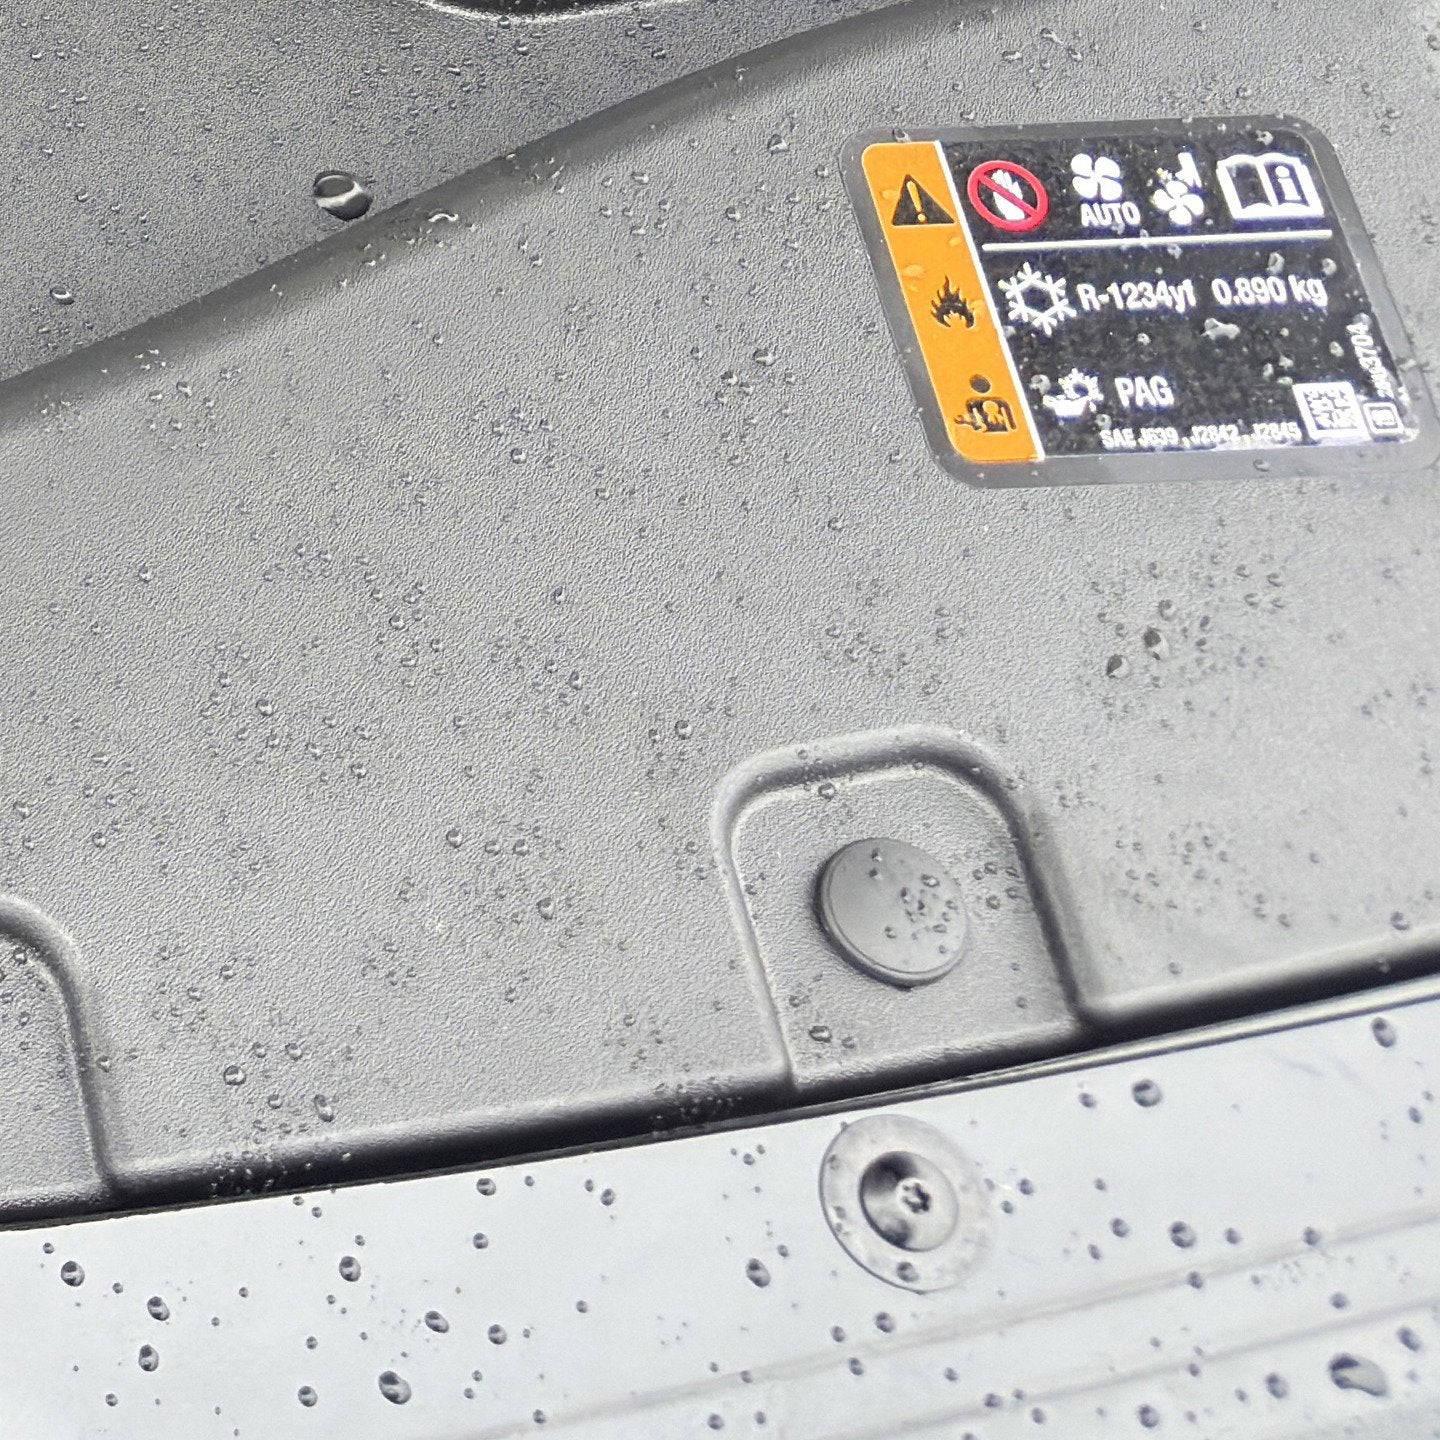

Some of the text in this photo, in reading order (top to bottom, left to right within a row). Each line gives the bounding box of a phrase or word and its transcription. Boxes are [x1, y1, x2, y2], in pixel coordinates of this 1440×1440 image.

[1080, 201, 1141, 227] AUTO
[1076, 274, 1328, 313] R-1234yf 0.890 kg
[1115, 376, 1174, 407] PAG
[1100, 428, 1136, 449] SAE
